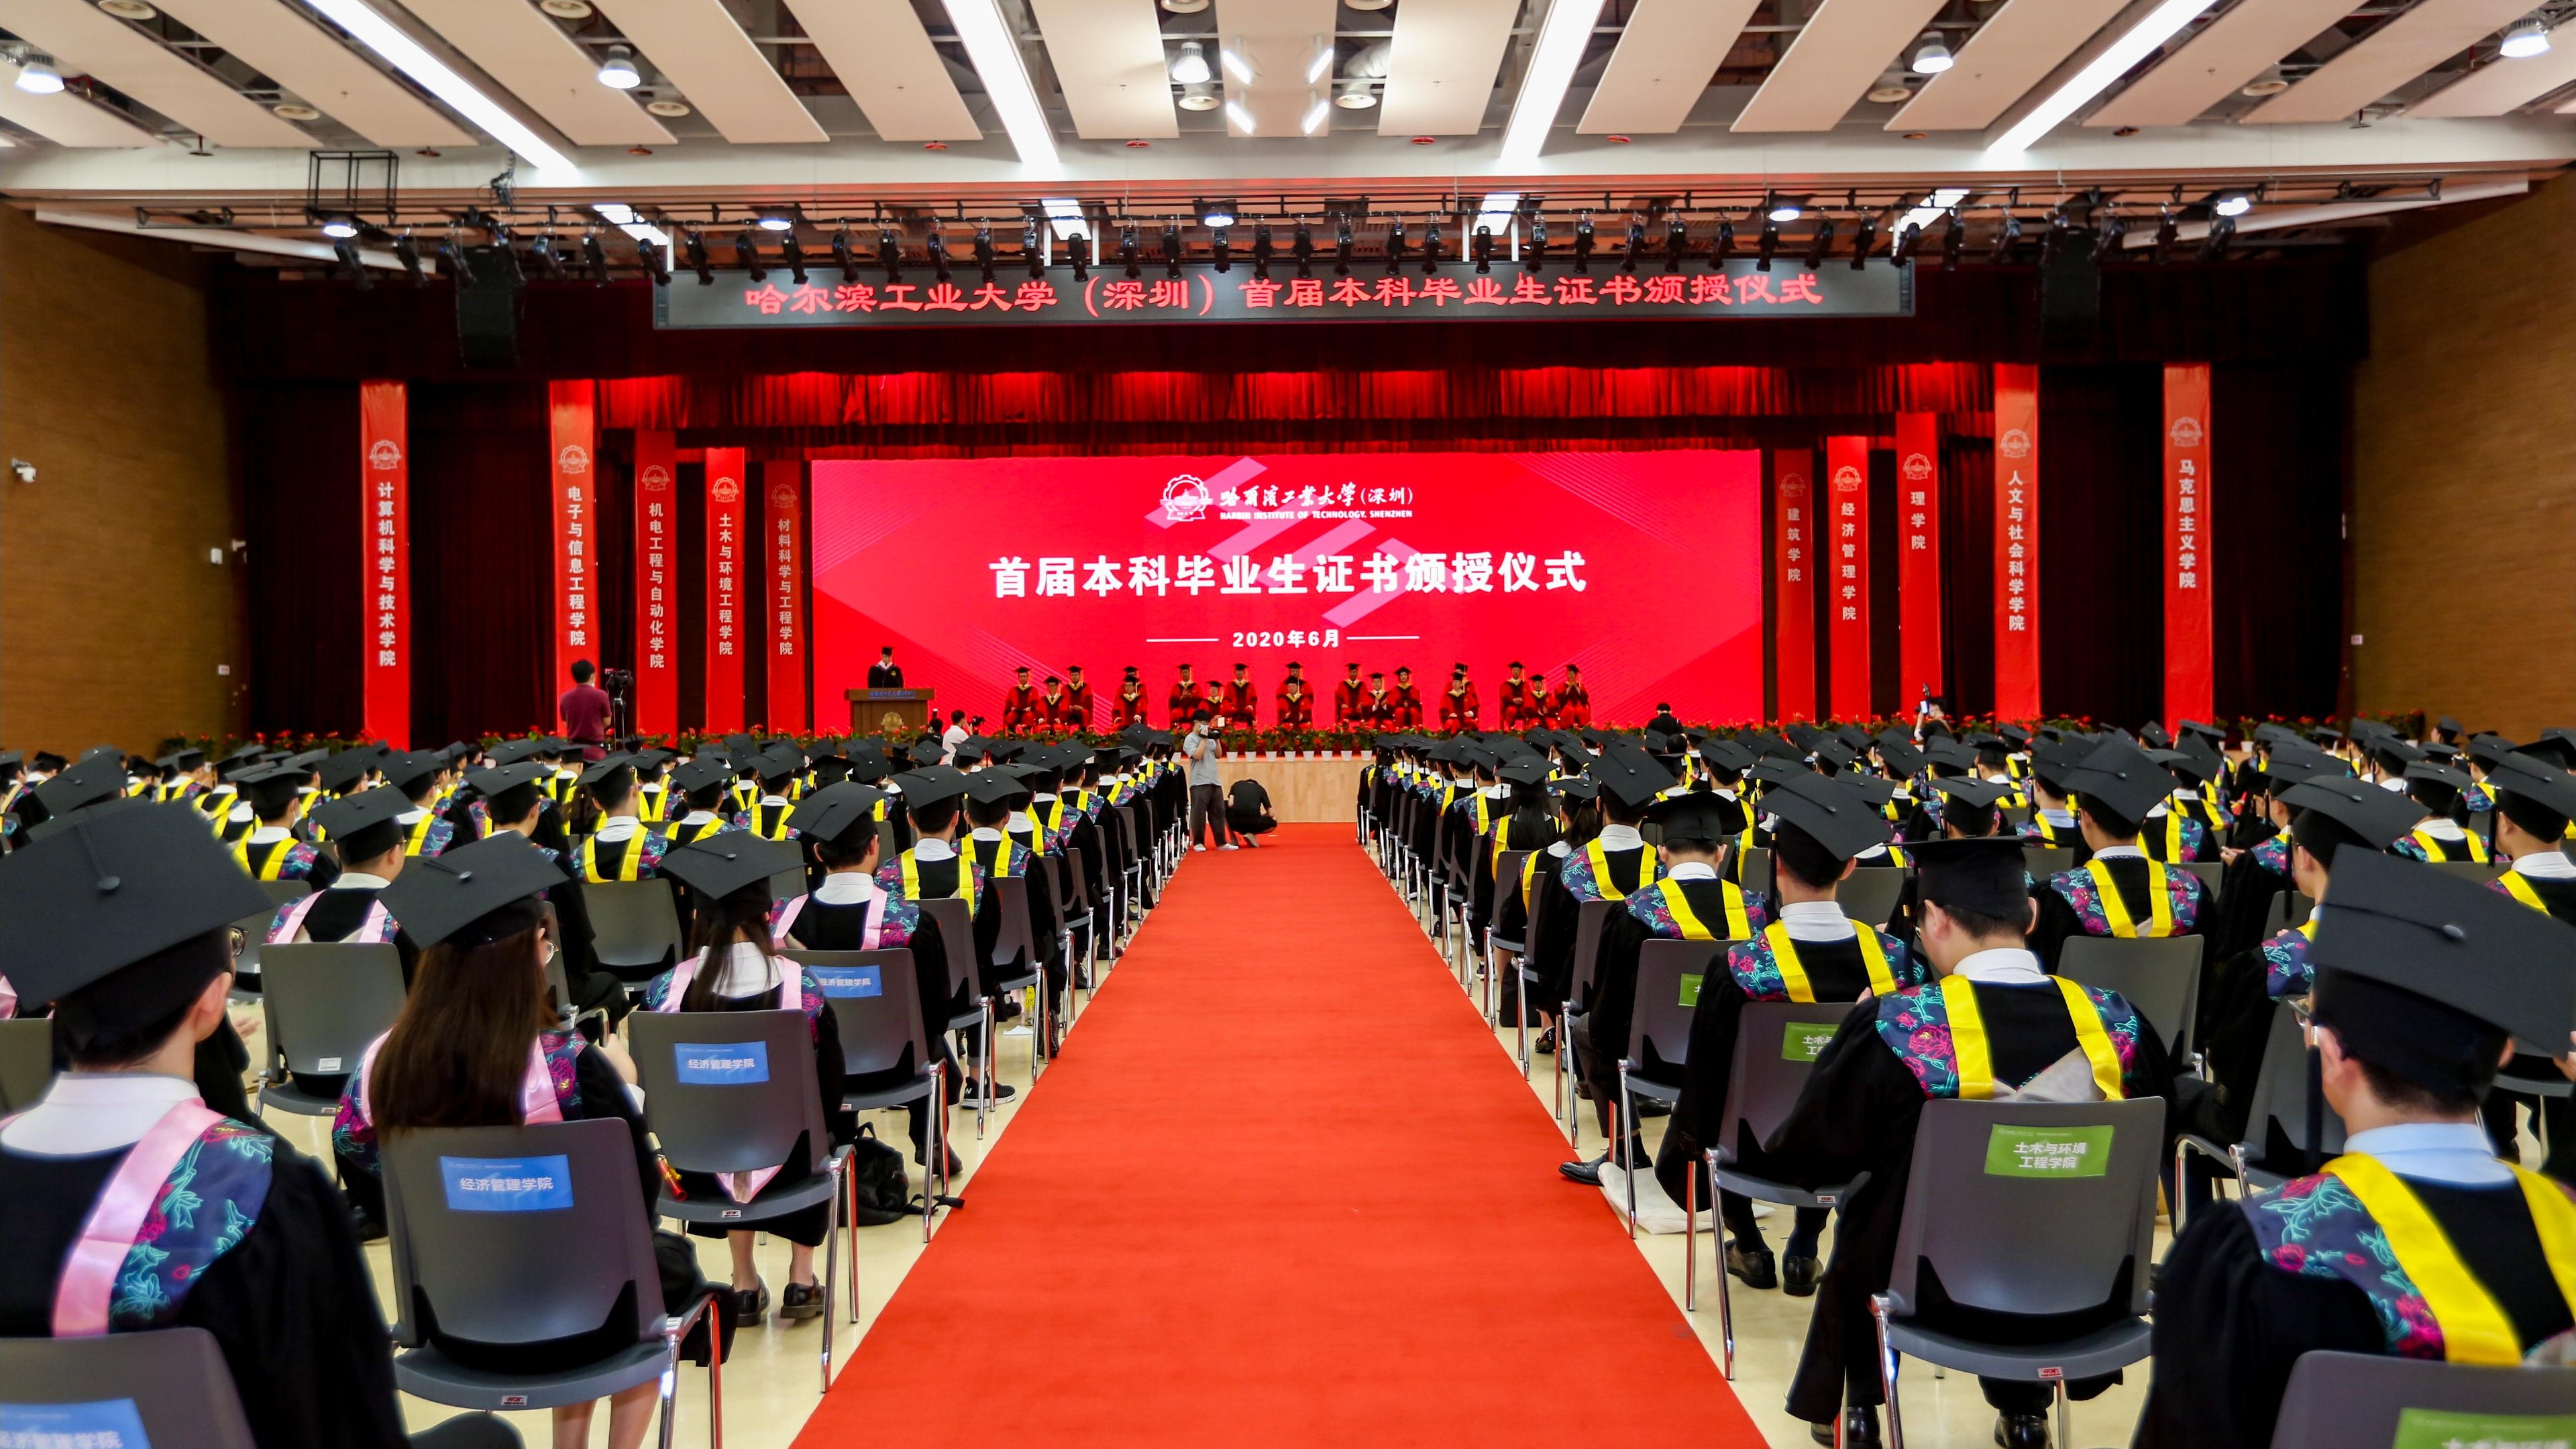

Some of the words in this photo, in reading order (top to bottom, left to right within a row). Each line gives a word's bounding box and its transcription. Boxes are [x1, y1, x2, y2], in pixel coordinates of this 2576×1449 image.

[1254, 511, 1295, 519] INSTITUTE
[1369, 510, 1413, 518] SHENZHEN
[1787, 508, 1801, 582] 建筑学院
[1910, 491, 1927, 550] 理学院
[2008, 470, 2025, 631] 人文与社会科学学院
[2179, 460, 2196, 588] 马克思主义学院
[377, 482, 396, 666] 计算机科学与技术学院
[567, 486, 586, 646] 电子与信息工程学院
[649, 502, 665, 668] 机电工程与自动化学院
[718, 513, 733, 655] 土木与环境工程学院
[777, 519, 793, 655] 材料科学与工程学院
[989, 550, 1587, 598] 首届本科毕业生证书颁授仪式
[1841, 502, 1857, 621] 经济管理学院
[1232, 629, 1338, 648] 2020年6月
[688, 1058, 755, 1069] 经济管理学院
[460, 1177, 554, 1191] 经济管理学院
[2013, 1142, 2086, 1155] 土木与环境
[2019, 1157, 2077, 1169] 工程学院
